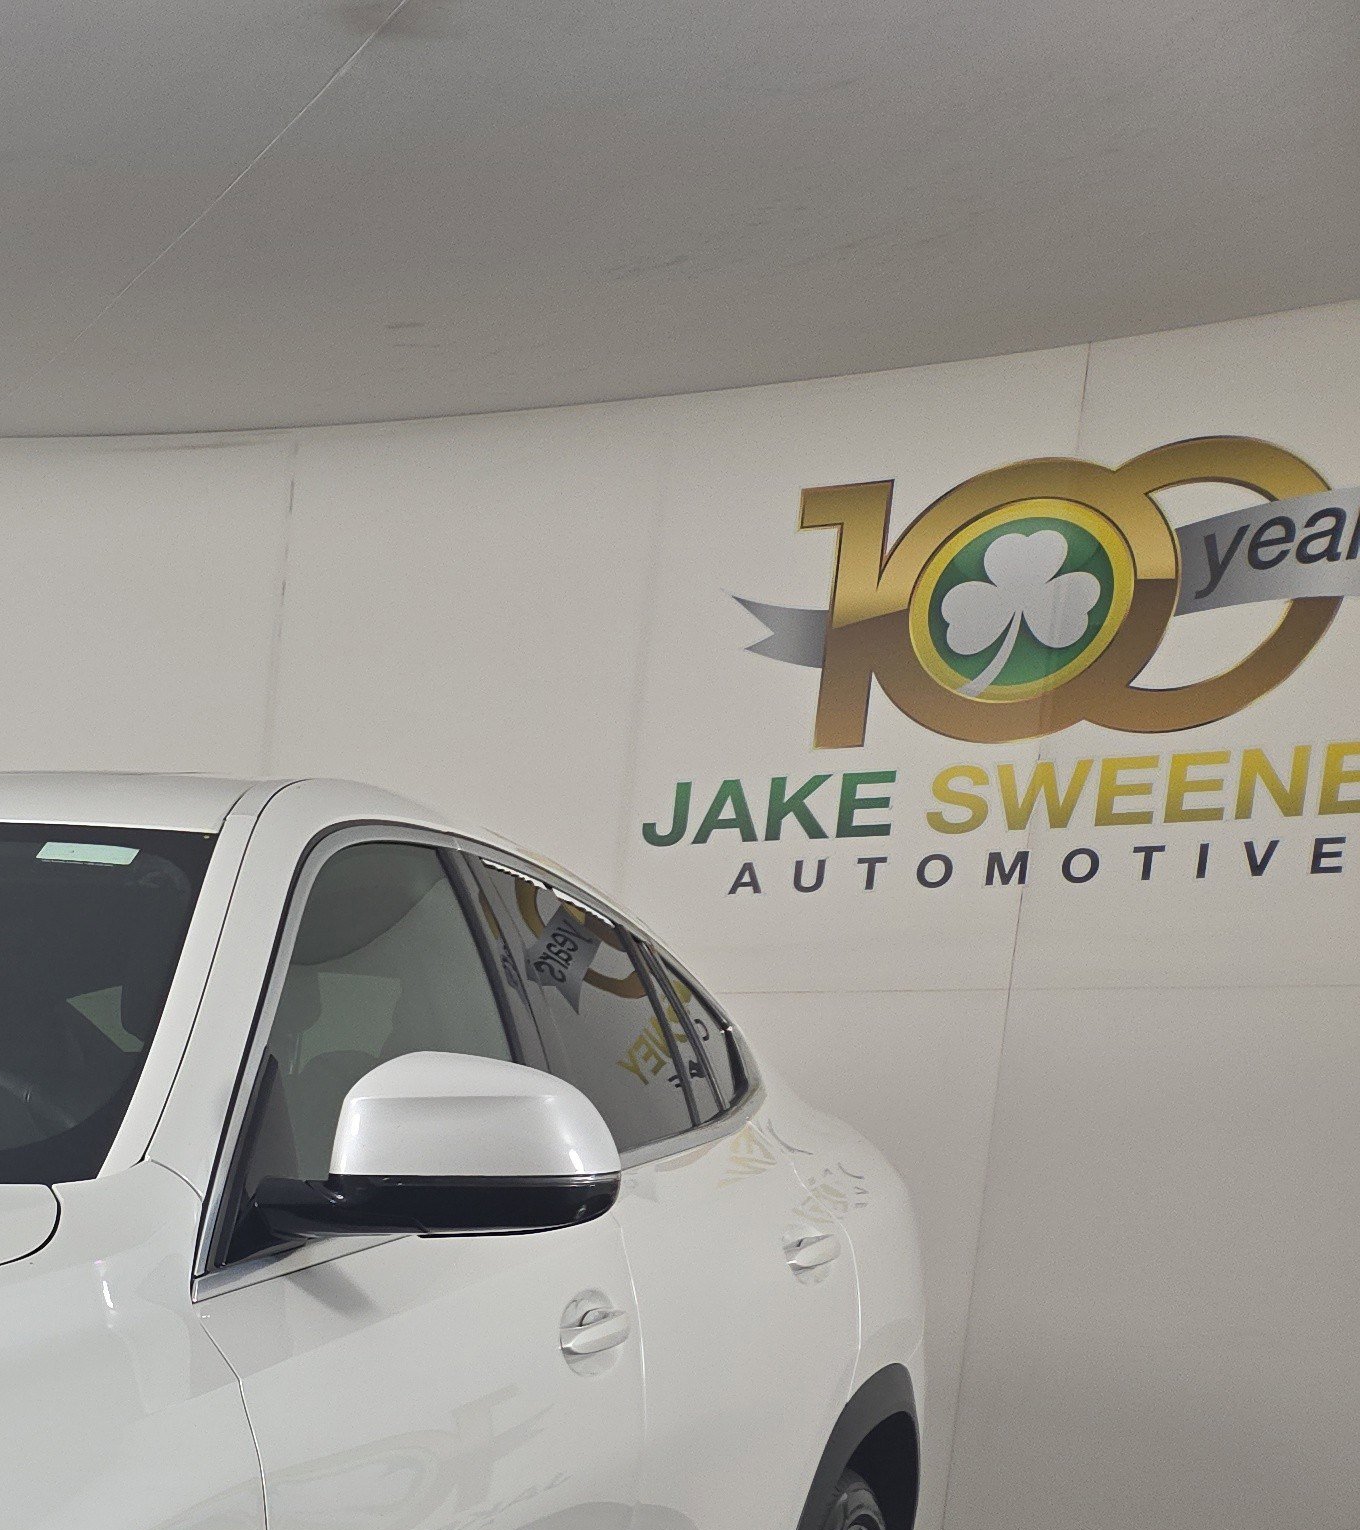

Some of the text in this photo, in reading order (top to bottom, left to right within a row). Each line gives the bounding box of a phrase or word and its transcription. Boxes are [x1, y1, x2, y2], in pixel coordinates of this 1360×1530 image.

[799, 435, 1360, 750] 100 yea
[642, 770, 897, 847] JAKE
[729, 836, 1346, 895] AUTOMOTIVE
